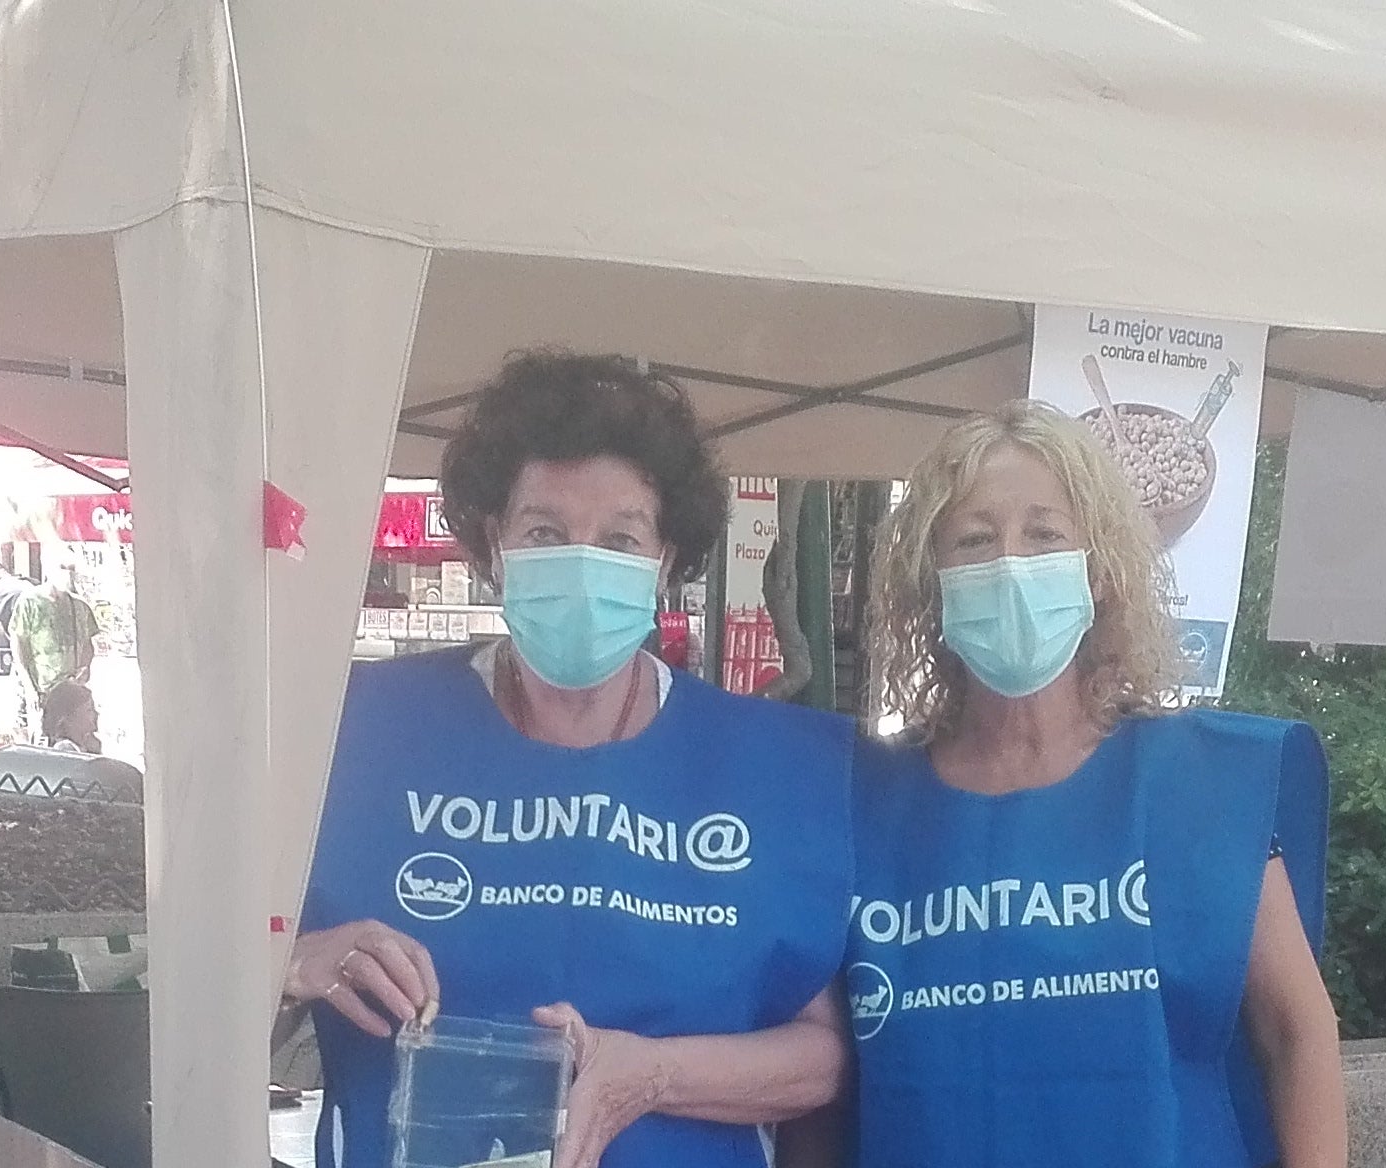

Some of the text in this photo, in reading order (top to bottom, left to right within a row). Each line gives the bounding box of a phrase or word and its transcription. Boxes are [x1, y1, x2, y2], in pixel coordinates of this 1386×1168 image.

[1088, 311, 1223, 350] La mejor vacuna
[1100, 344, 1208, 370] contra el hambre
[735, 543, 766, 560] Plaza
[406, 790, 753, 873] VOLUNTARI@
[480, 884, 739, 927] BANCO DE ALIMENTOS
[900, 967, 1160, 1011] BANCO DE ALIMENTO
